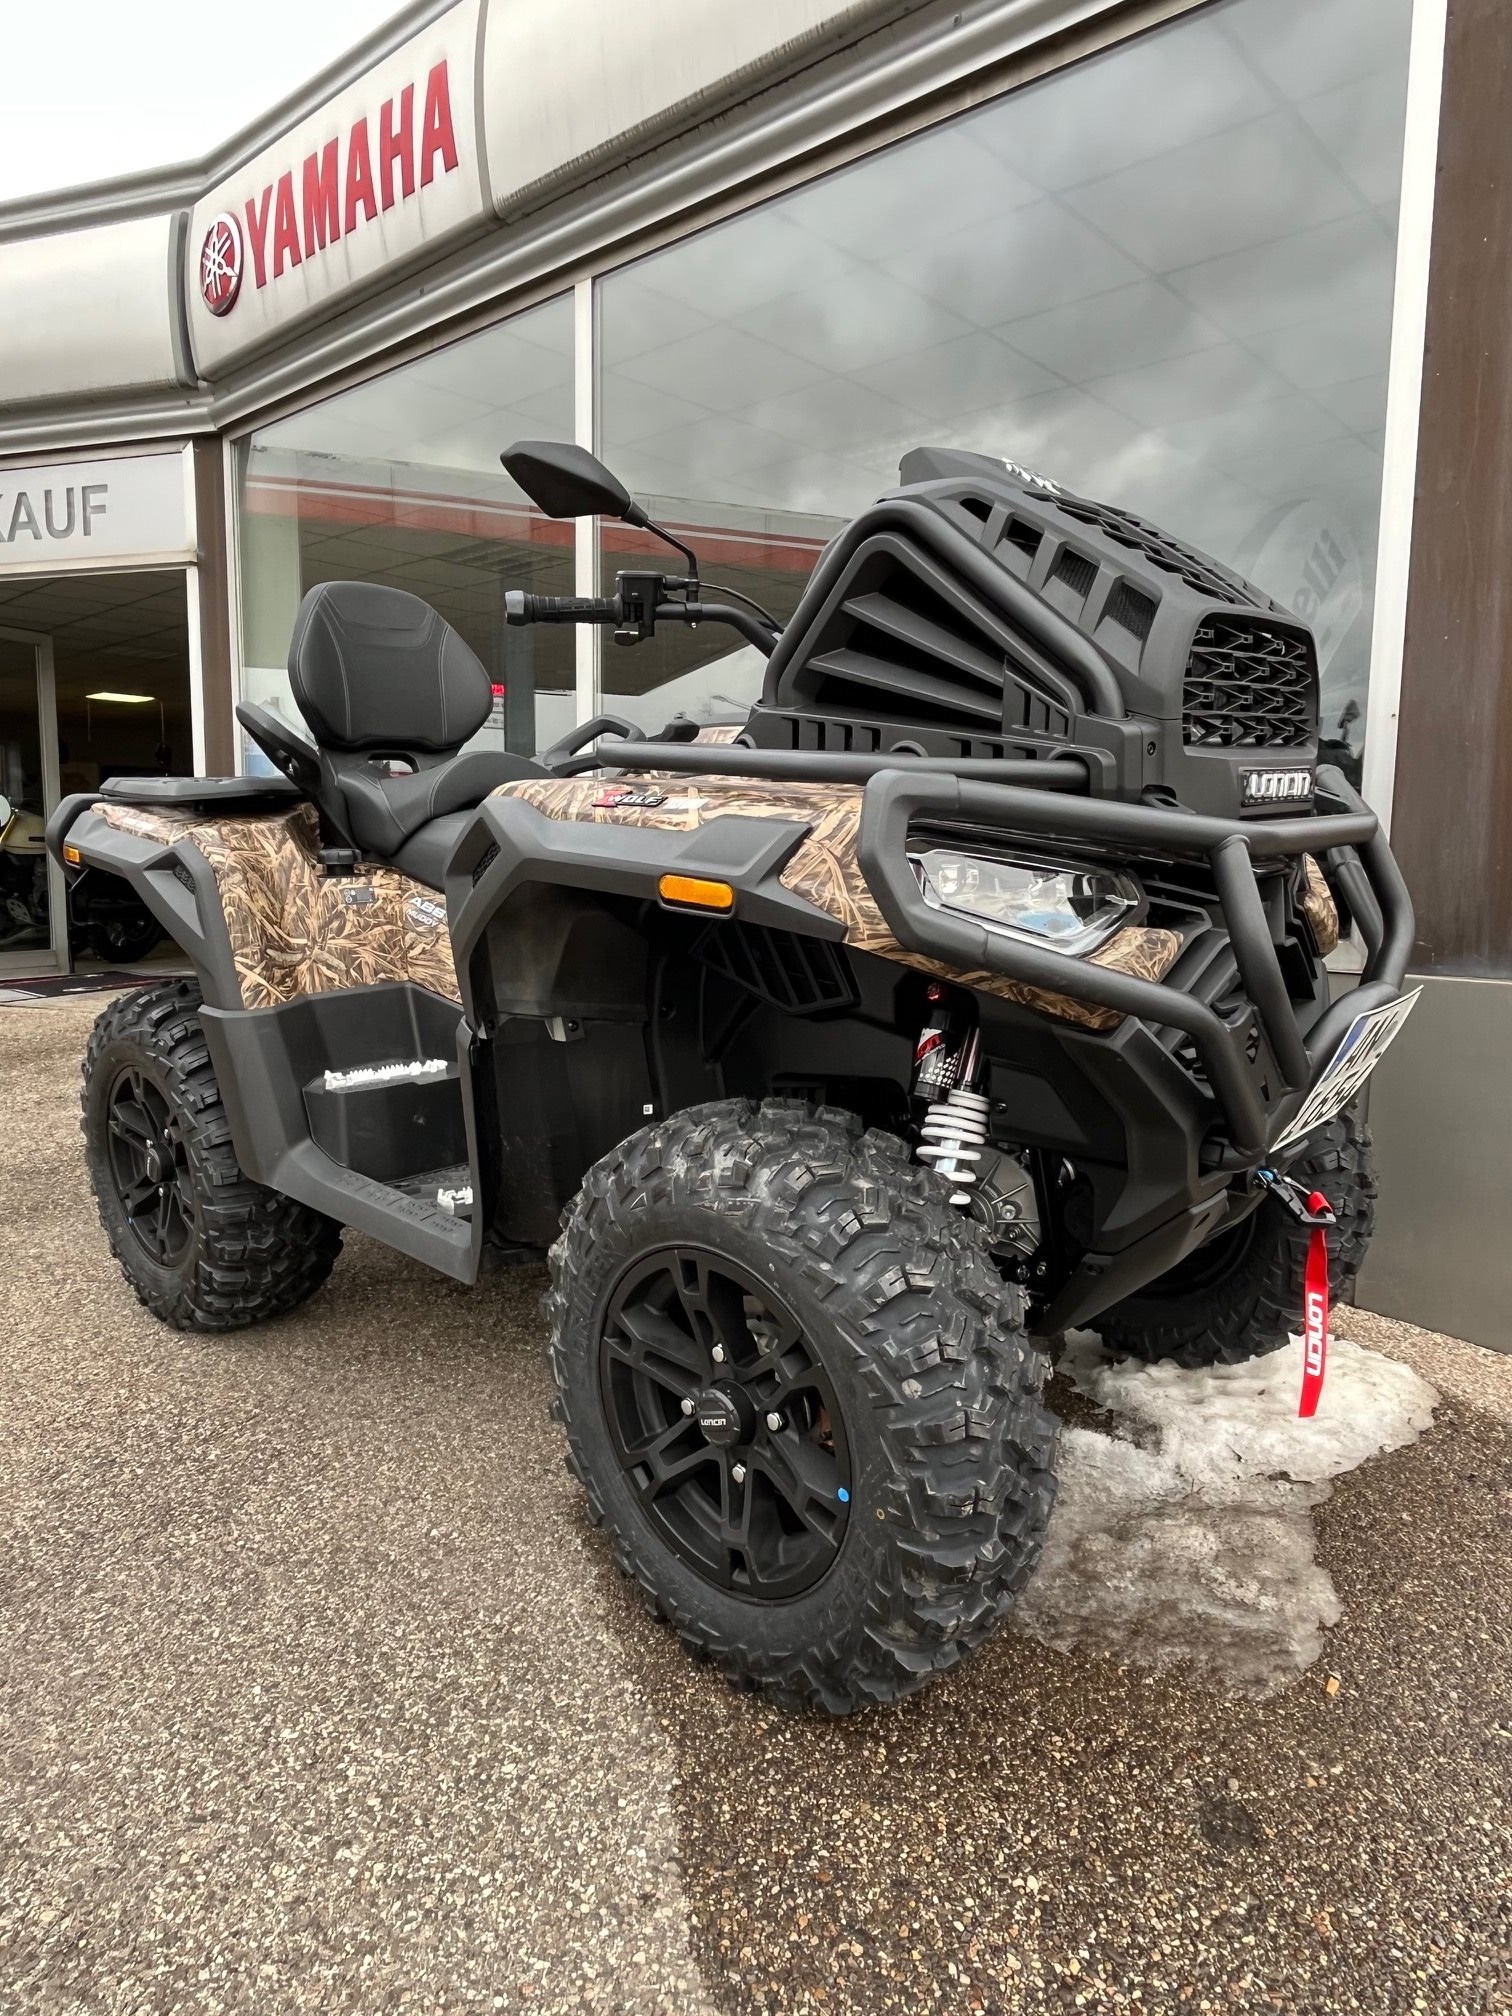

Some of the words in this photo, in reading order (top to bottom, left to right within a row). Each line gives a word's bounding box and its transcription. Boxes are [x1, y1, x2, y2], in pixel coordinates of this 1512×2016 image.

[245, 59, 459, 289] YAMAHA
[0, 484, 108, 543] AUF
[1293, 528, 1347, 623] elli
[406, 908, 439, 927] MUDDY
[408, 896, 447, 919] ABS
